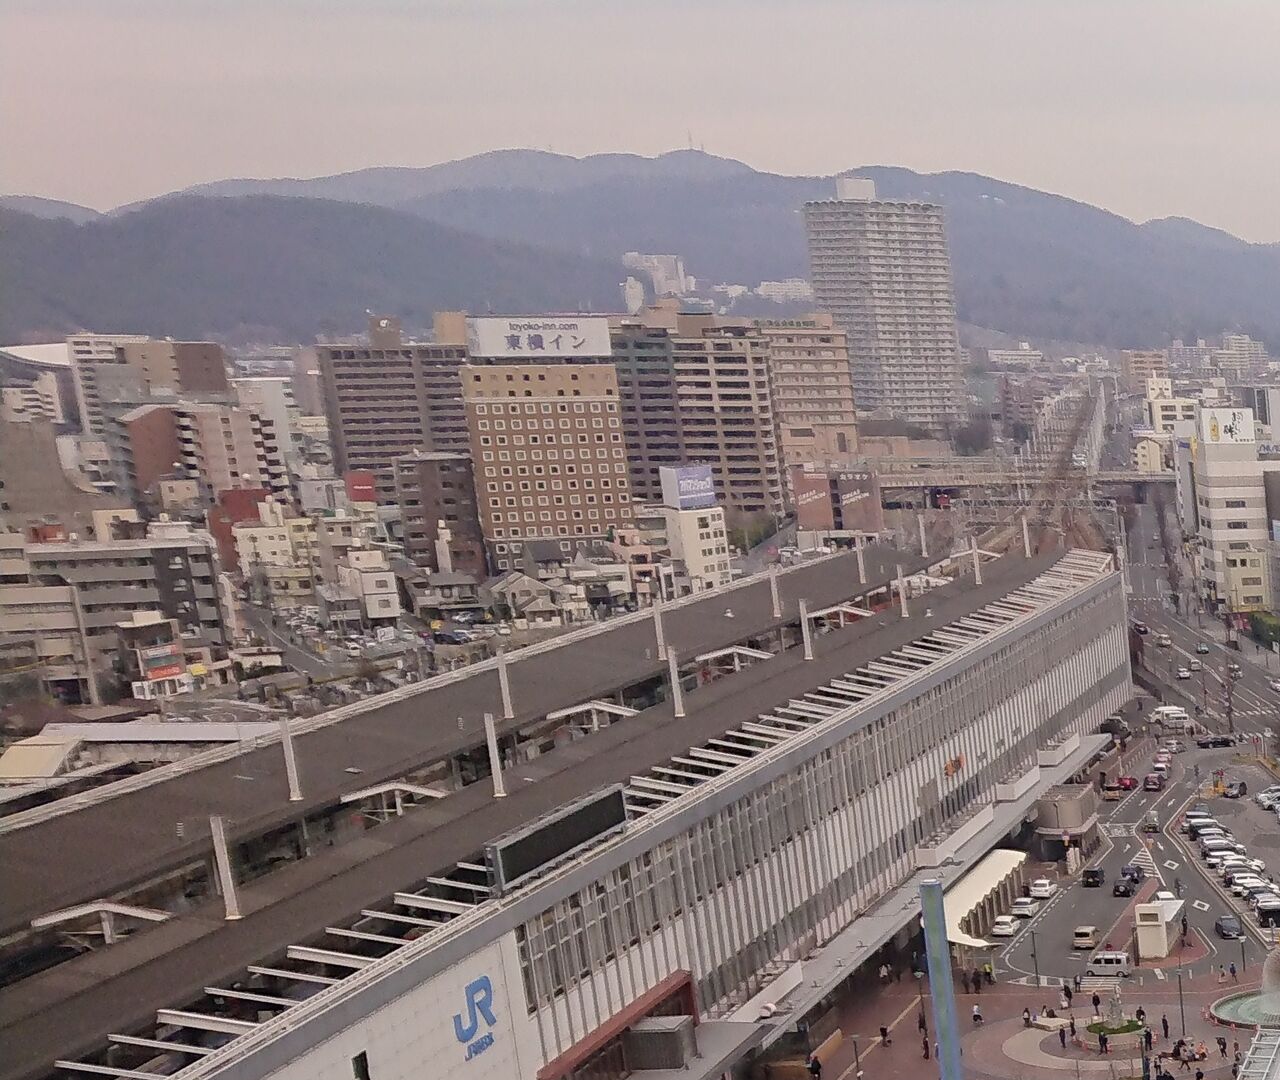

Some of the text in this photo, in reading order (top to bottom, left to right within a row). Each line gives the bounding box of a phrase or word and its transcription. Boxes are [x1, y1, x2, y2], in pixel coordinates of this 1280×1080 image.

[509, 322, 578, 332] toyoko-inn.com
[504, 333, 586, 350] 東横イン
[453, 975, 497, 1043] JR
